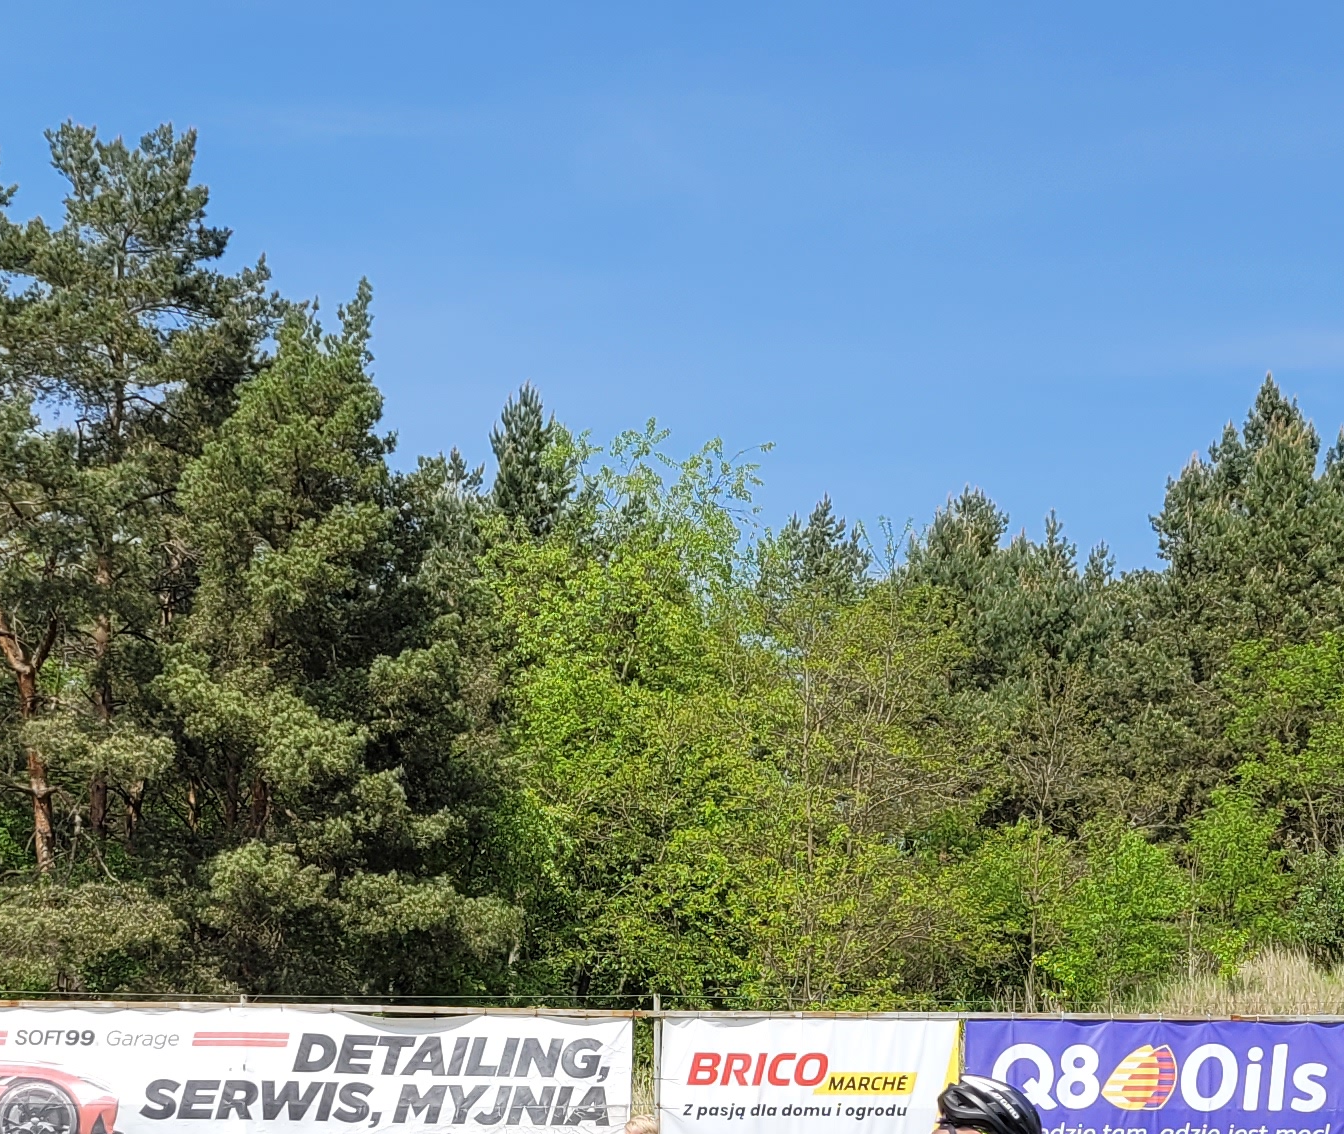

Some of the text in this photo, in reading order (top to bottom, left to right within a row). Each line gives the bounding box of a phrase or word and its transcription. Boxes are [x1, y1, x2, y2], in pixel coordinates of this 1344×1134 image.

[15, 1029, 180, 1050] SOFT99 Garage
[292, 1033, 610, 1083] DETAILING,
[686, 1052, 909, 1091] BRICO MARCHÉ
[991, 1043, 1099, 1111] Q8
[1181, 1043, 1328, 1113] Oils
[139, 1079, 610, 1129] SERWIS, MYJNIA
[683, 1104, 908, 1121] Z pasją dla domu i ogrodu
